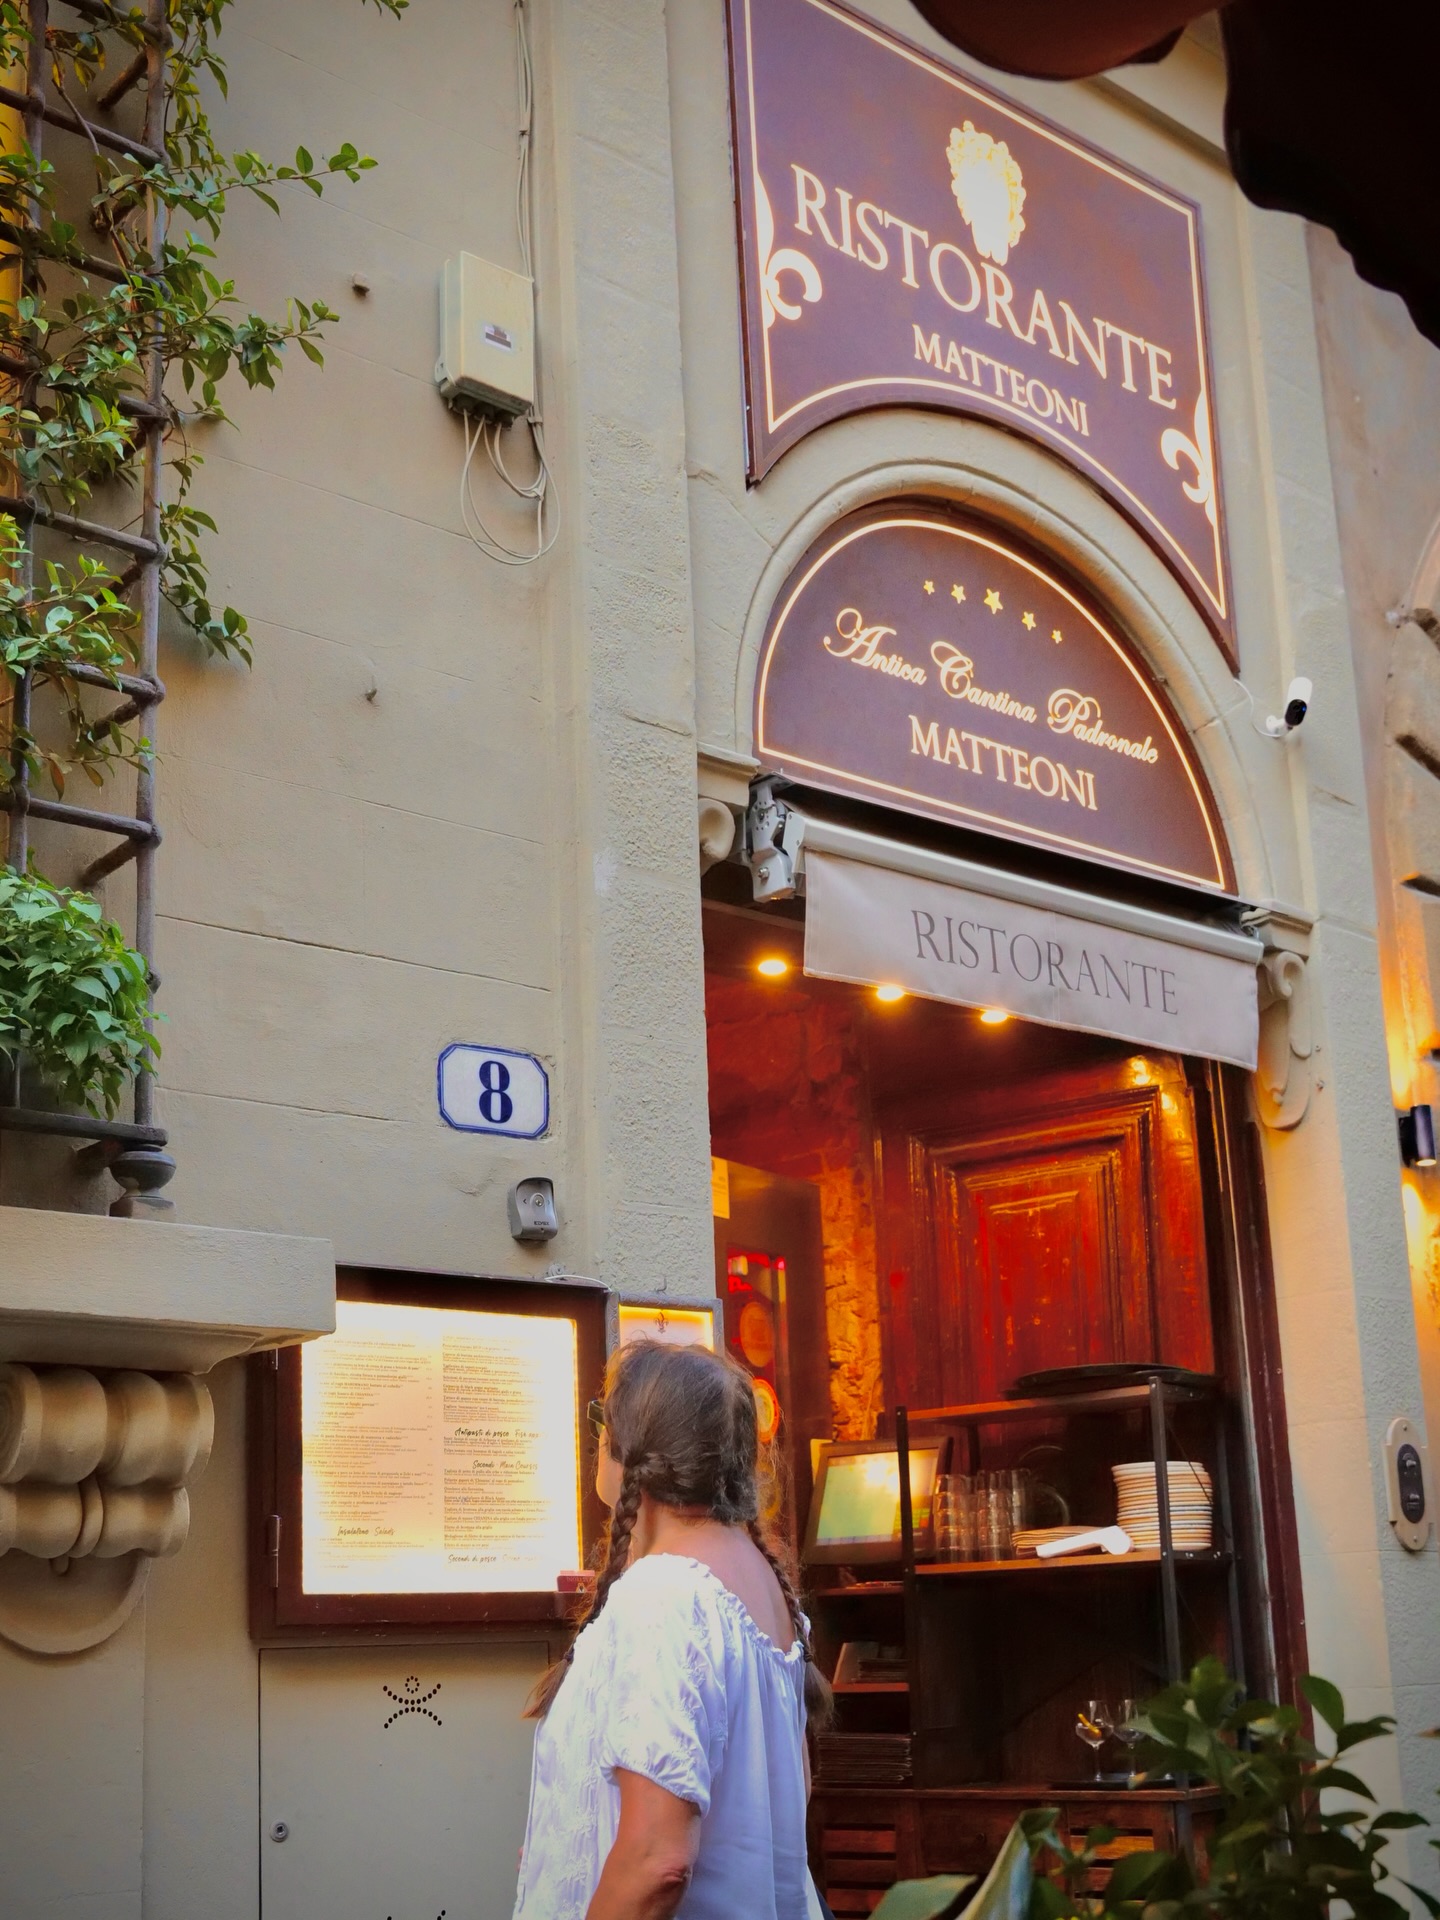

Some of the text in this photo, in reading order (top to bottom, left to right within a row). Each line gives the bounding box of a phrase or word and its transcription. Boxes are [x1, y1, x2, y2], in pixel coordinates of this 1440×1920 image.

[791, 164, 1177, 410] RISTORANTE
[912, 325, 1090, 437] MATTEONI
[824, 608, 1159, 764] Antica Cantina Padronale
[908, 715, 1098, 811] MATTEONI
[911, 910, 1179, 1016] RISTORANTE
[478, 1060, 513, 1124] 8
